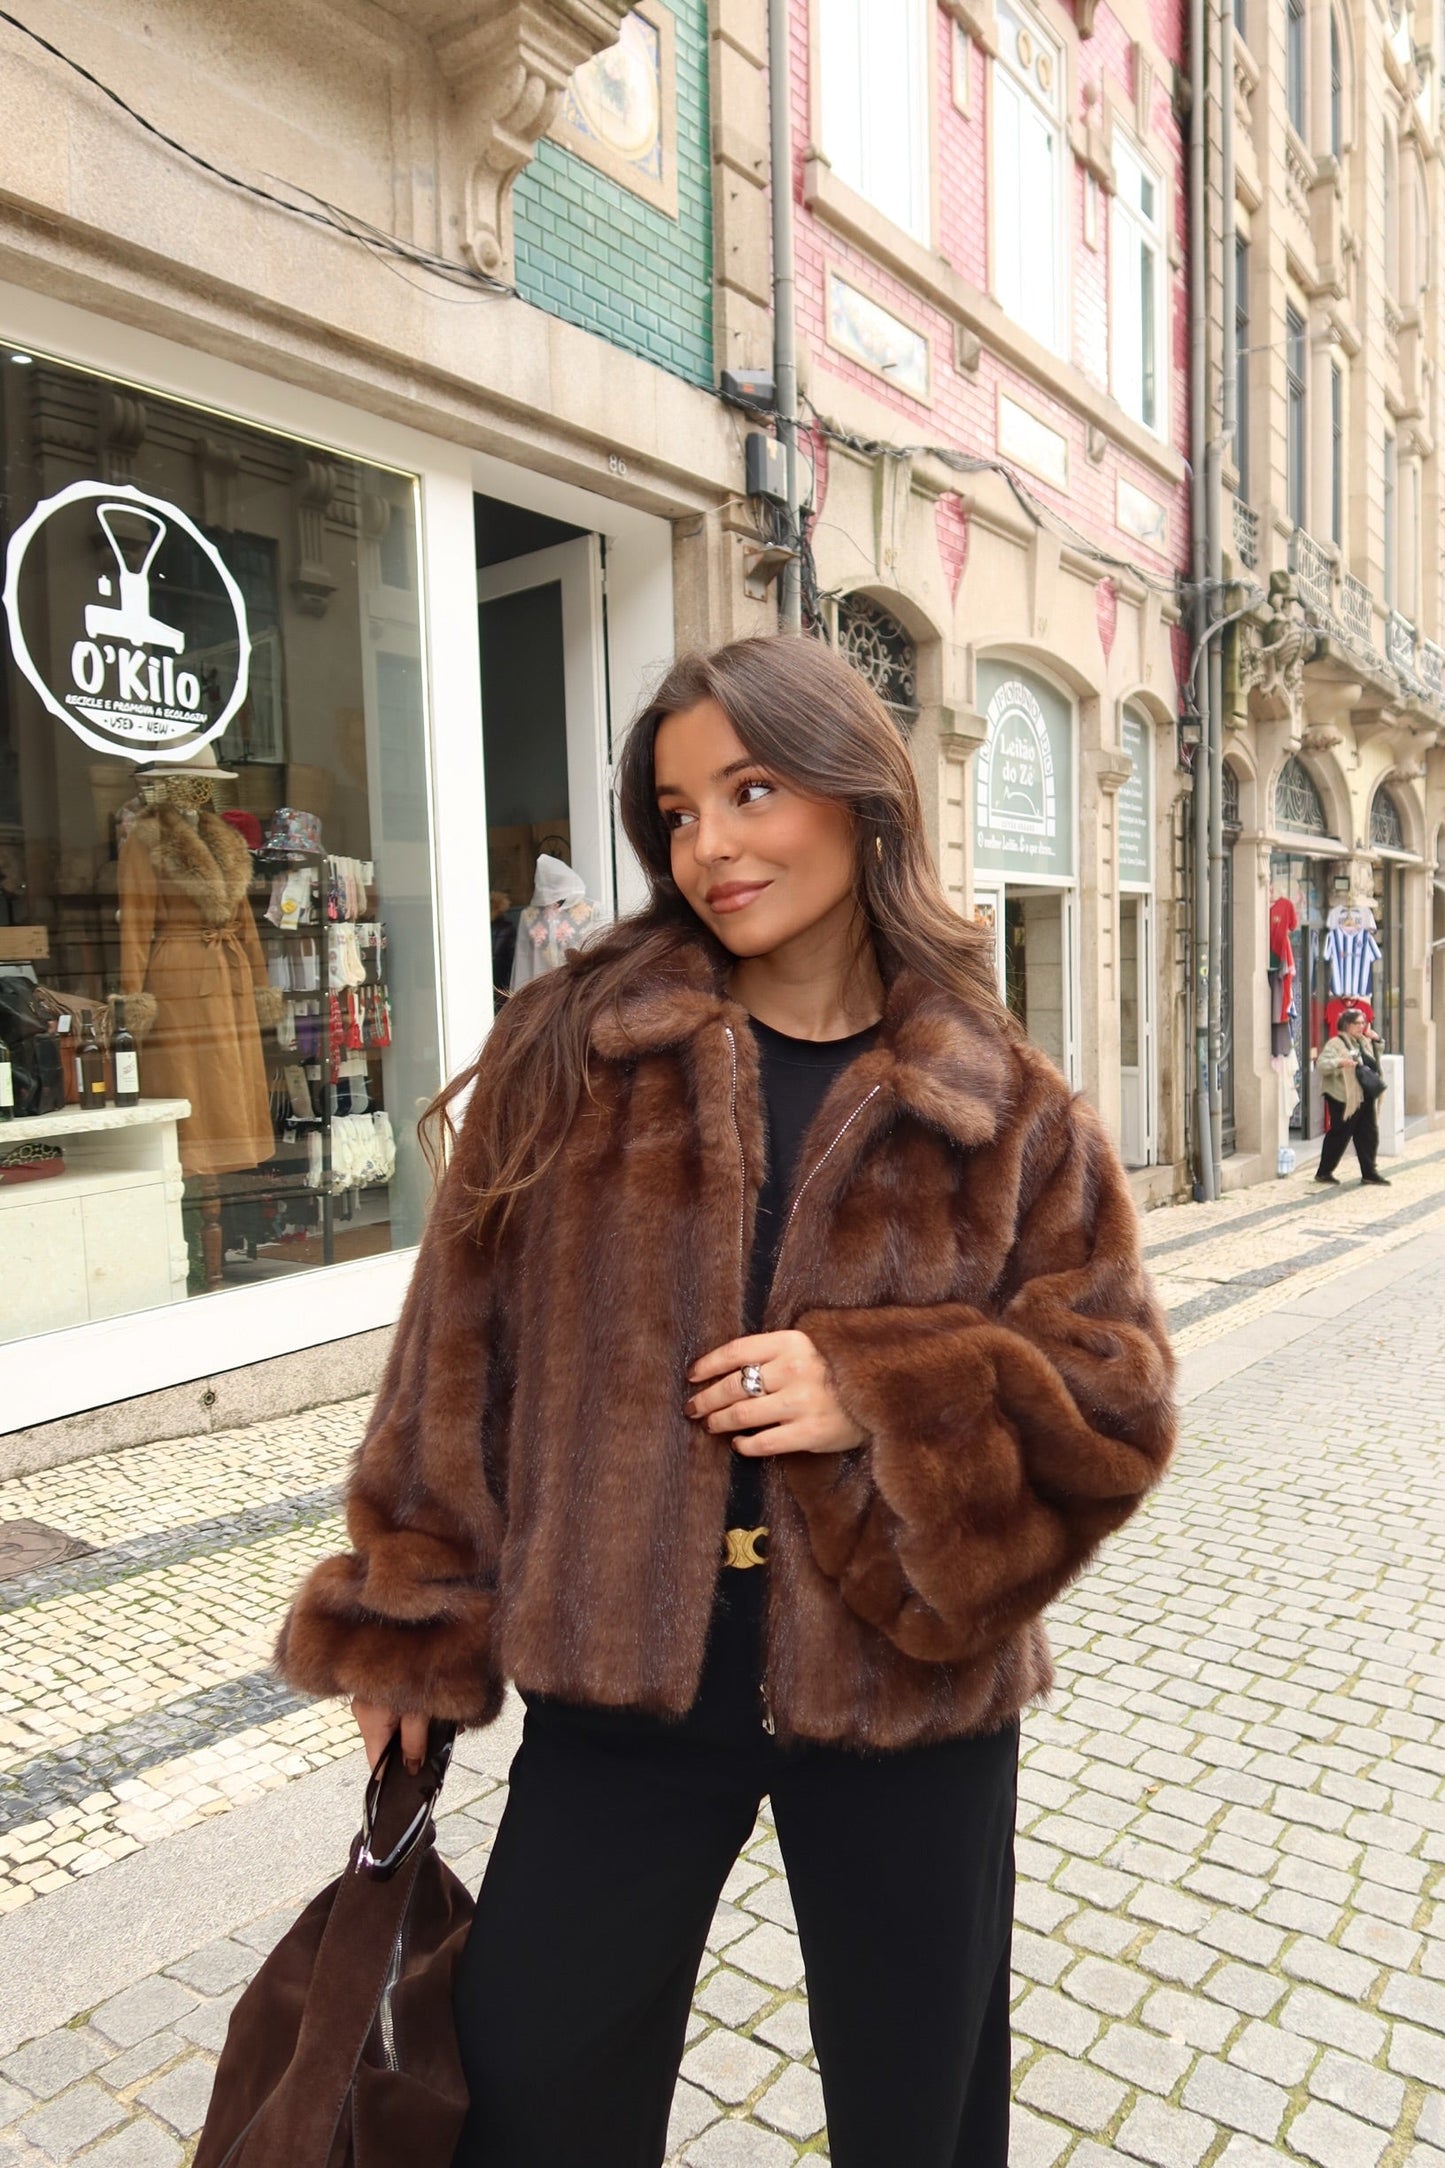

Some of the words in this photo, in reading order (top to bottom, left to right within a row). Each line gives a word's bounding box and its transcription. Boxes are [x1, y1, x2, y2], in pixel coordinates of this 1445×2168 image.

[609, 454, 627, 475] 86
[71, 640, 201, 710] O'Kilo
[65, 694, 103, 708] RECICLE
[104, 700, 112, 710] E
[113, 700, 154, 716] PROMOVA
[155, 707, 163, 717] A
[110, 717, 134, 730] USED
[147, 722, 168, 734] NEW
[1000, 733, 1035, 762] Leitão
[1002, 760, 1017, 783] do
[1019, 763, 1034, 787] Zé
